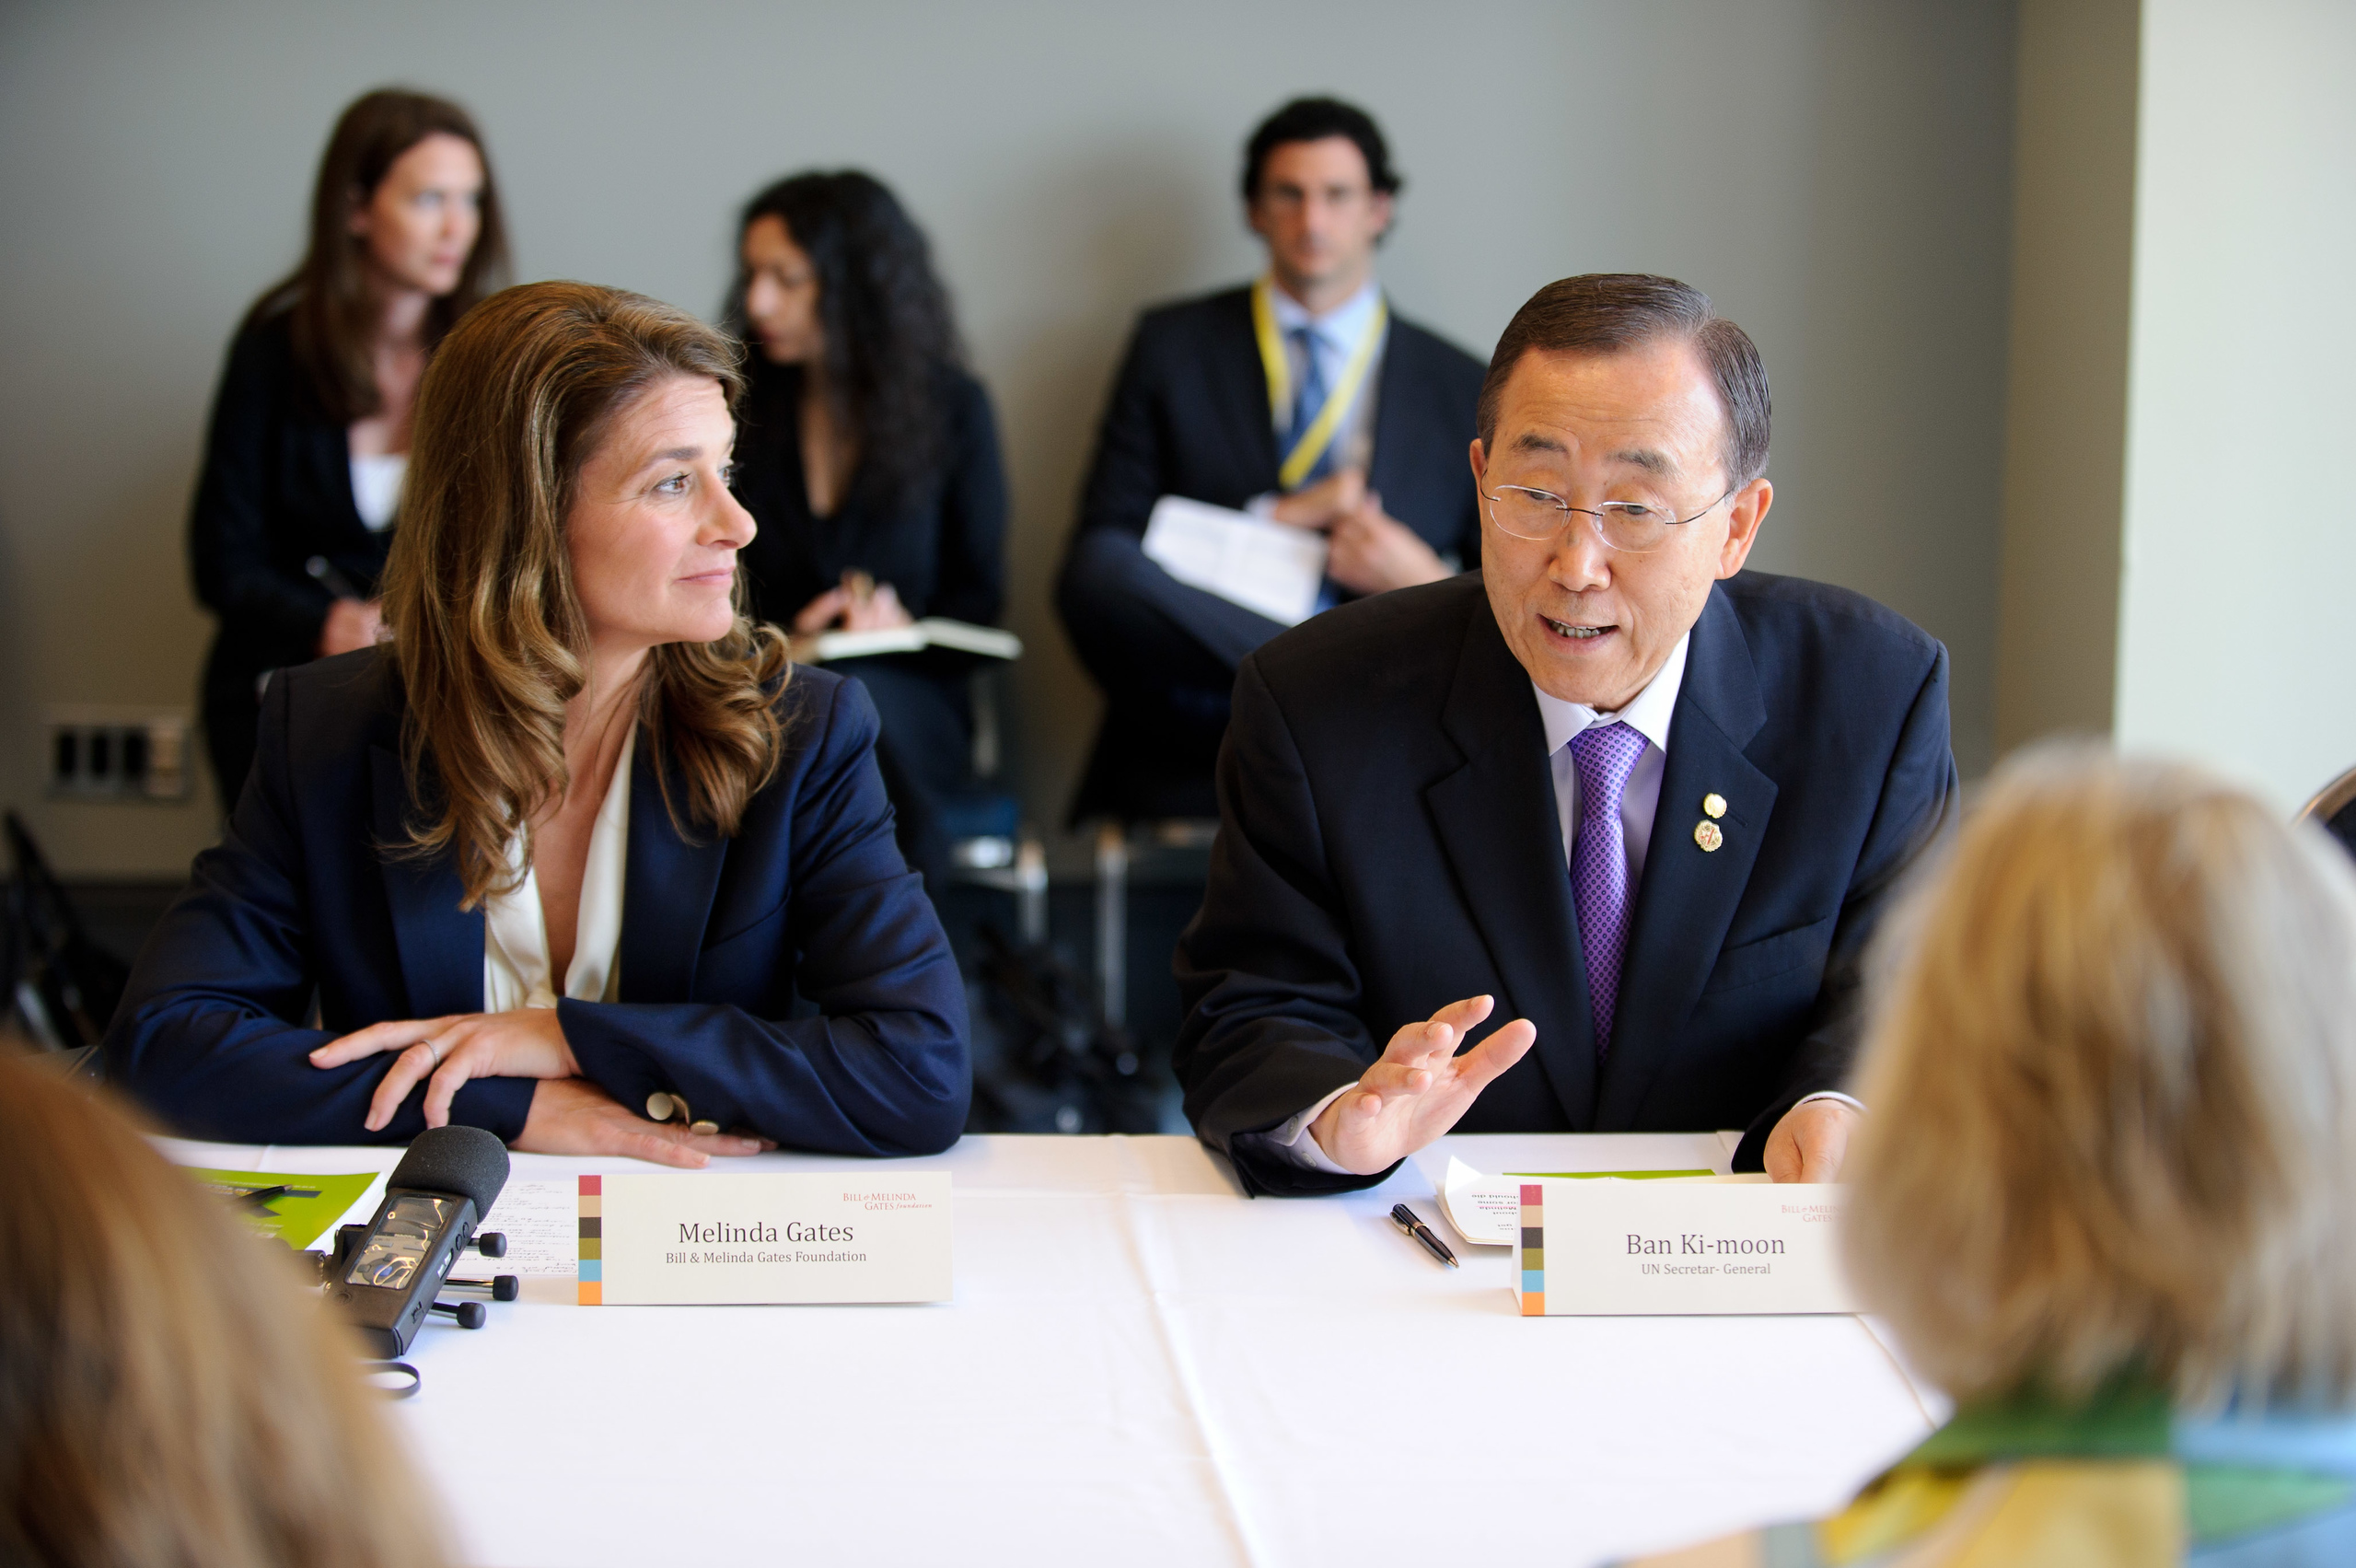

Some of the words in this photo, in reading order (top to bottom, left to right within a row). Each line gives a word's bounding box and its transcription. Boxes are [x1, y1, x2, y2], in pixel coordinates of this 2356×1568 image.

[871, 1192, 916, 1202] MELINDA
[865, 1202, 894, 1211] GATES
[896, 1202, 933, 1211] foundation
[679, 1222, 778, 1243] Melinda
[786, 1221, 853, 1242] Gates
[1626, 1234, 1672, 1254] Ban
[1680, 1234, 1785, 1254] Ki-moon
[666, 1252, 687, 1263] Bill
[690, 1252, 700, 1263] &
[703, 1252, 754, 1263] Melinda
[757, 1251, 792, 1262] Gates
[795, 1250, 867, 1262] Foundation
[1642, 1263, 1660, 1274] UN
[1664, 1263, 1720, 1275] Secretar-
[1723, 1263, 1771, 1274] General
